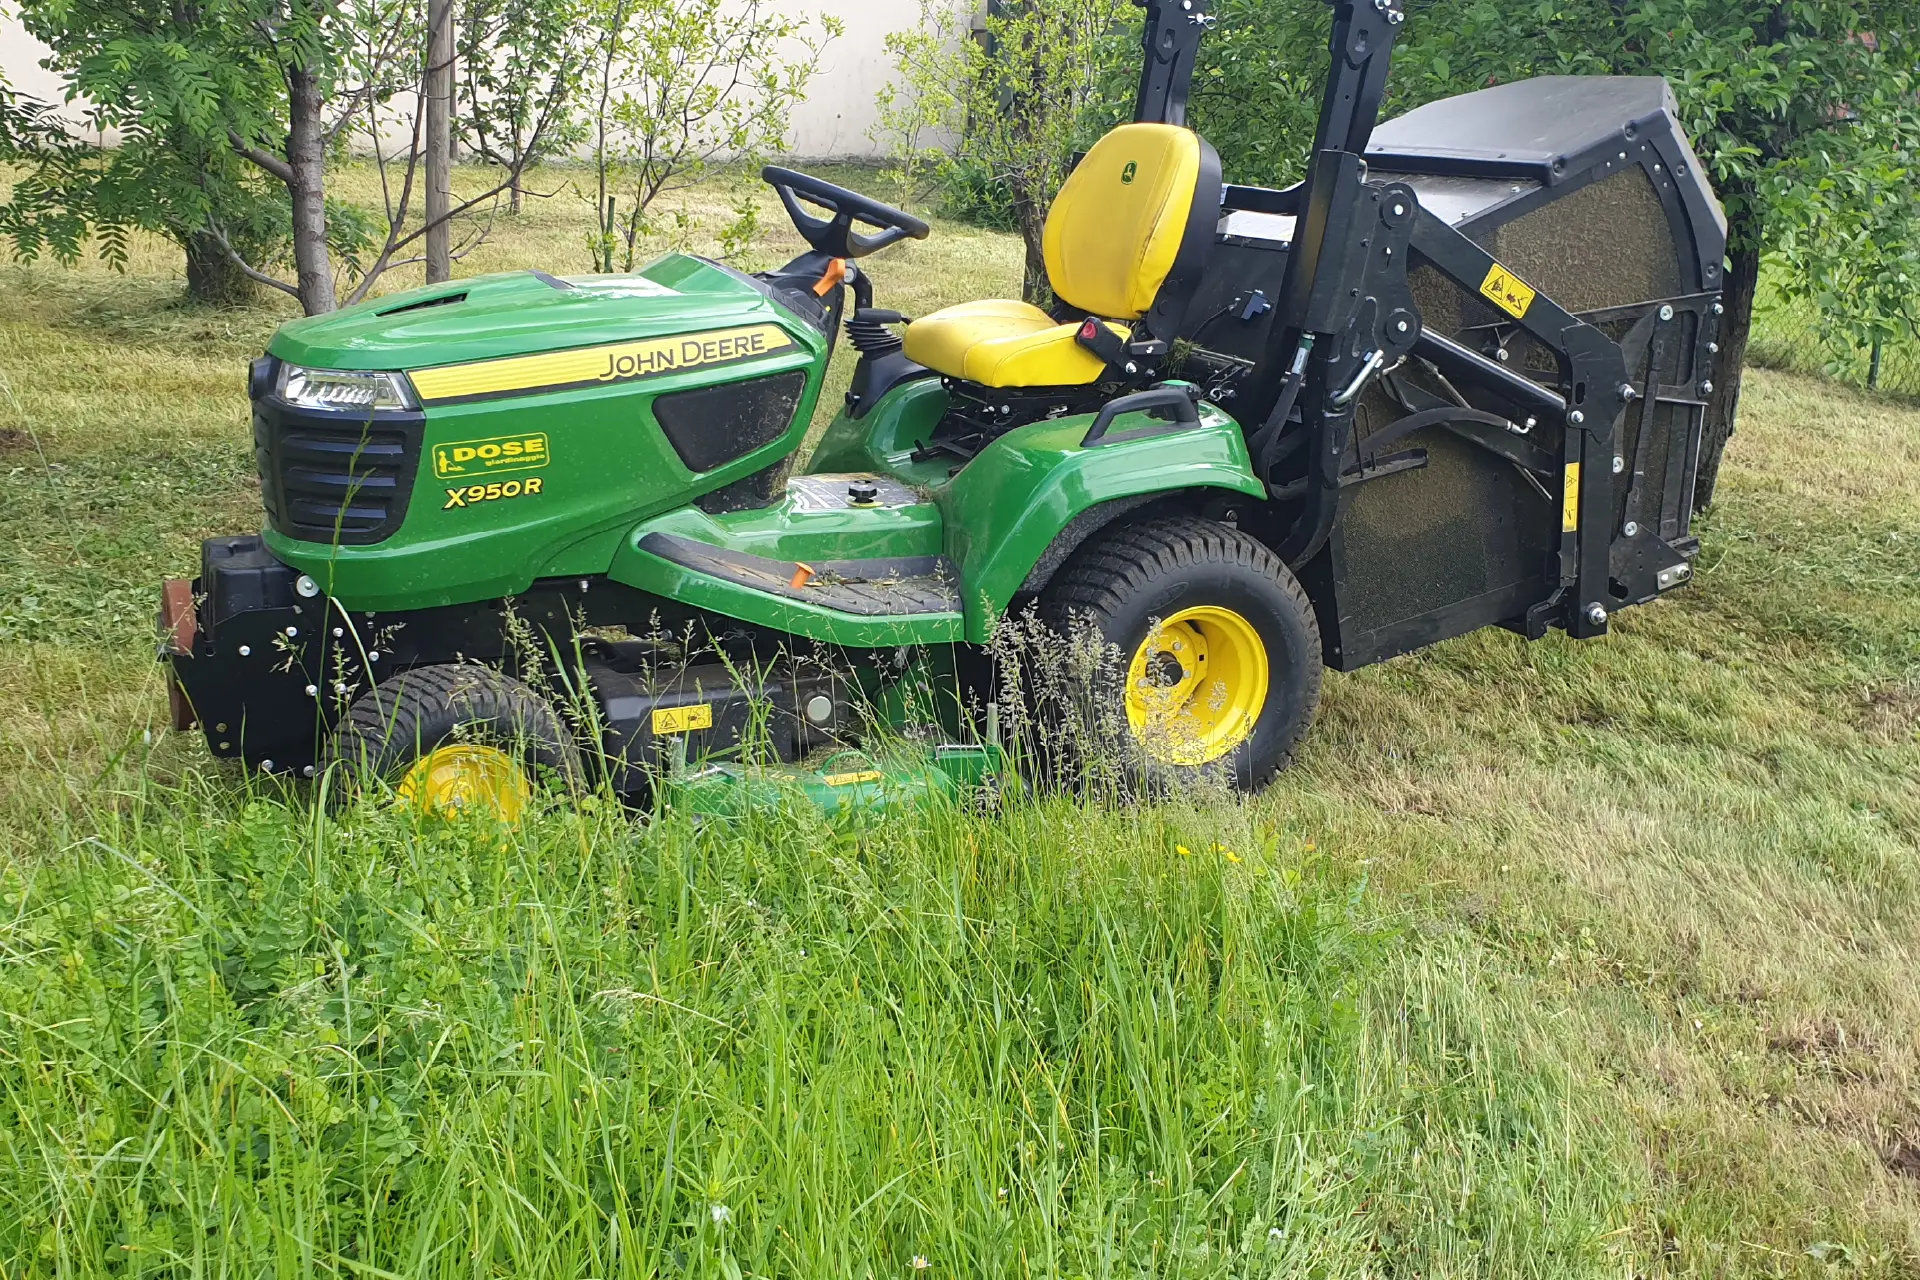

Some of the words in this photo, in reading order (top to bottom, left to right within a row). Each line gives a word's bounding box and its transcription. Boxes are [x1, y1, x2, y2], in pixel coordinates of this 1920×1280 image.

[599, 348, 675, 378] JOHN
[681, 333, 766, 364] DEERE
[453, 438, 545, 462] DOSE
[485, 453, 546, 467] giardinaggio
